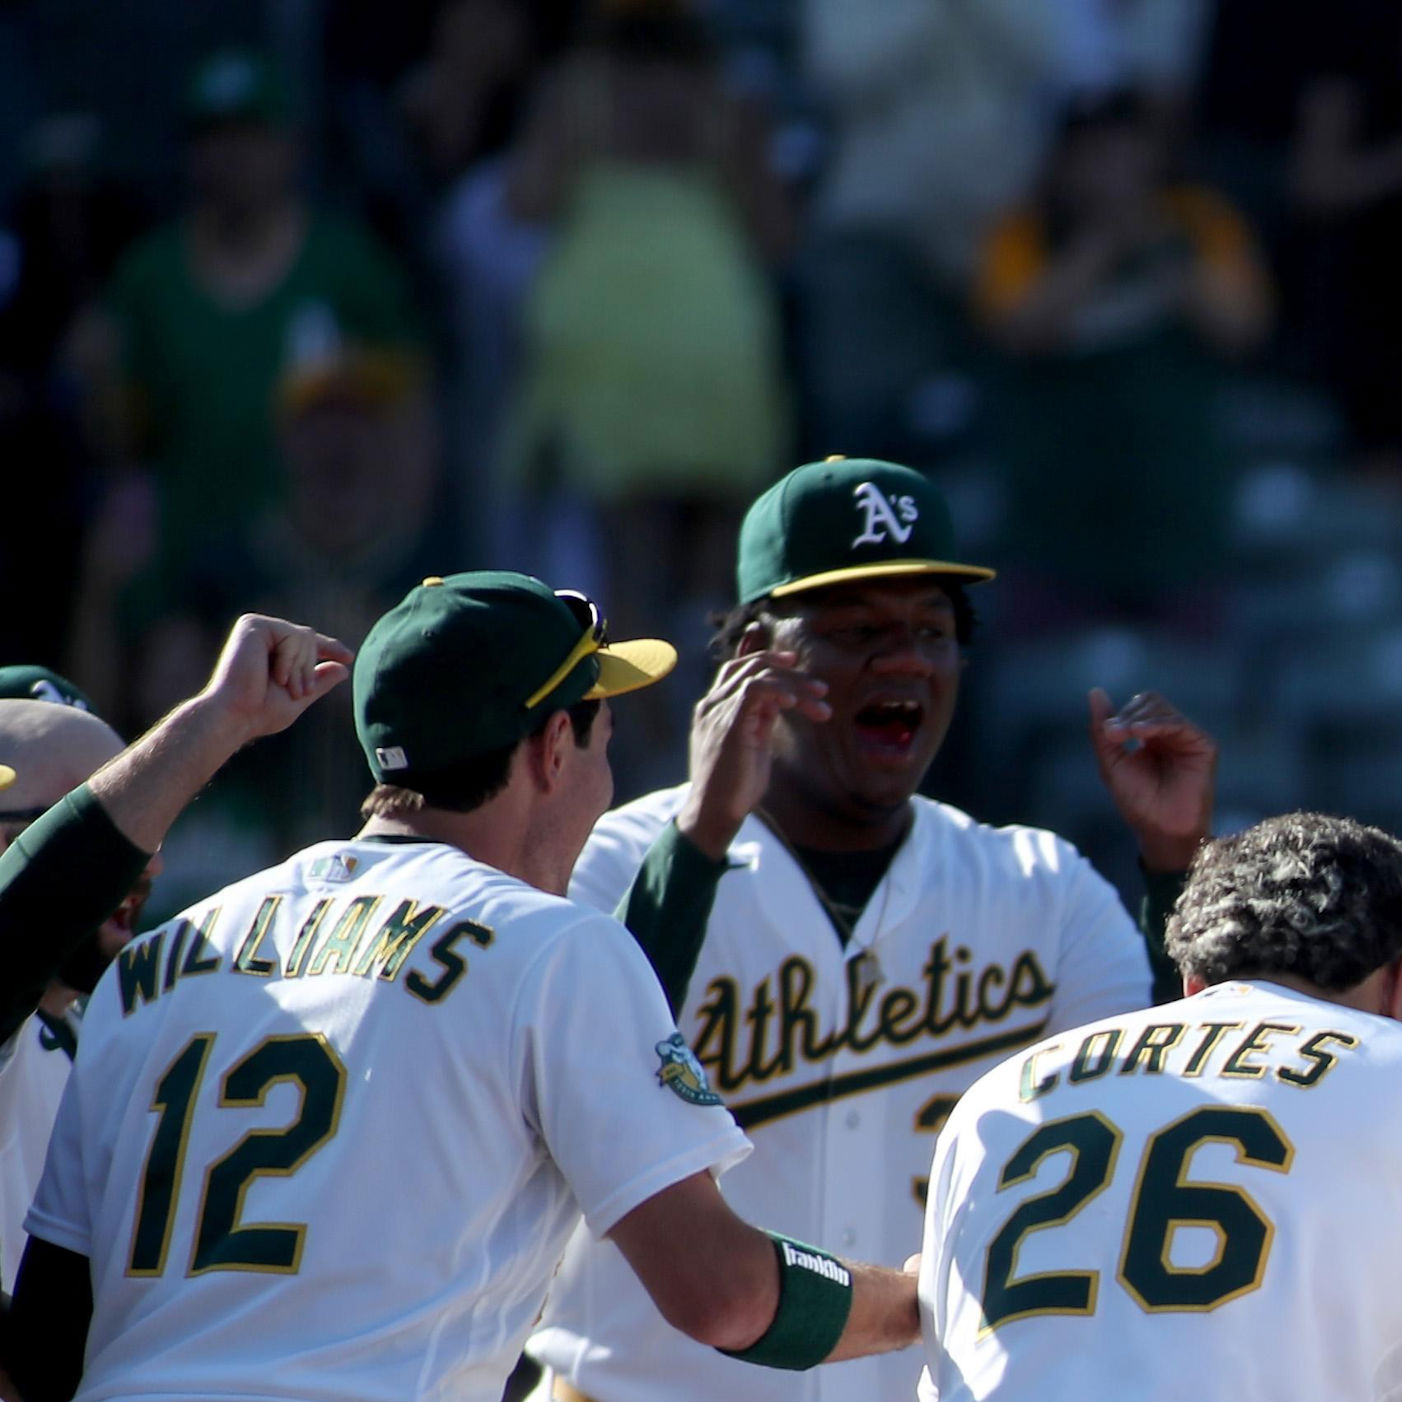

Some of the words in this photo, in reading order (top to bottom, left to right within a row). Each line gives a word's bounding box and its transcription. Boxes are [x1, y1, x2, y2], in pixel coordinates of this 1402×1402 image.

[851, 481, 918, 549] A's
[116, 894, 496, 1019] WILLIAMS
[694, 931, 1057, 1092] Athletics
[1018, 1021, 1361, 1103] CORTES
[124, 1031, 348, 1279] 12
[977, 1103, 1297, 1342] 26
